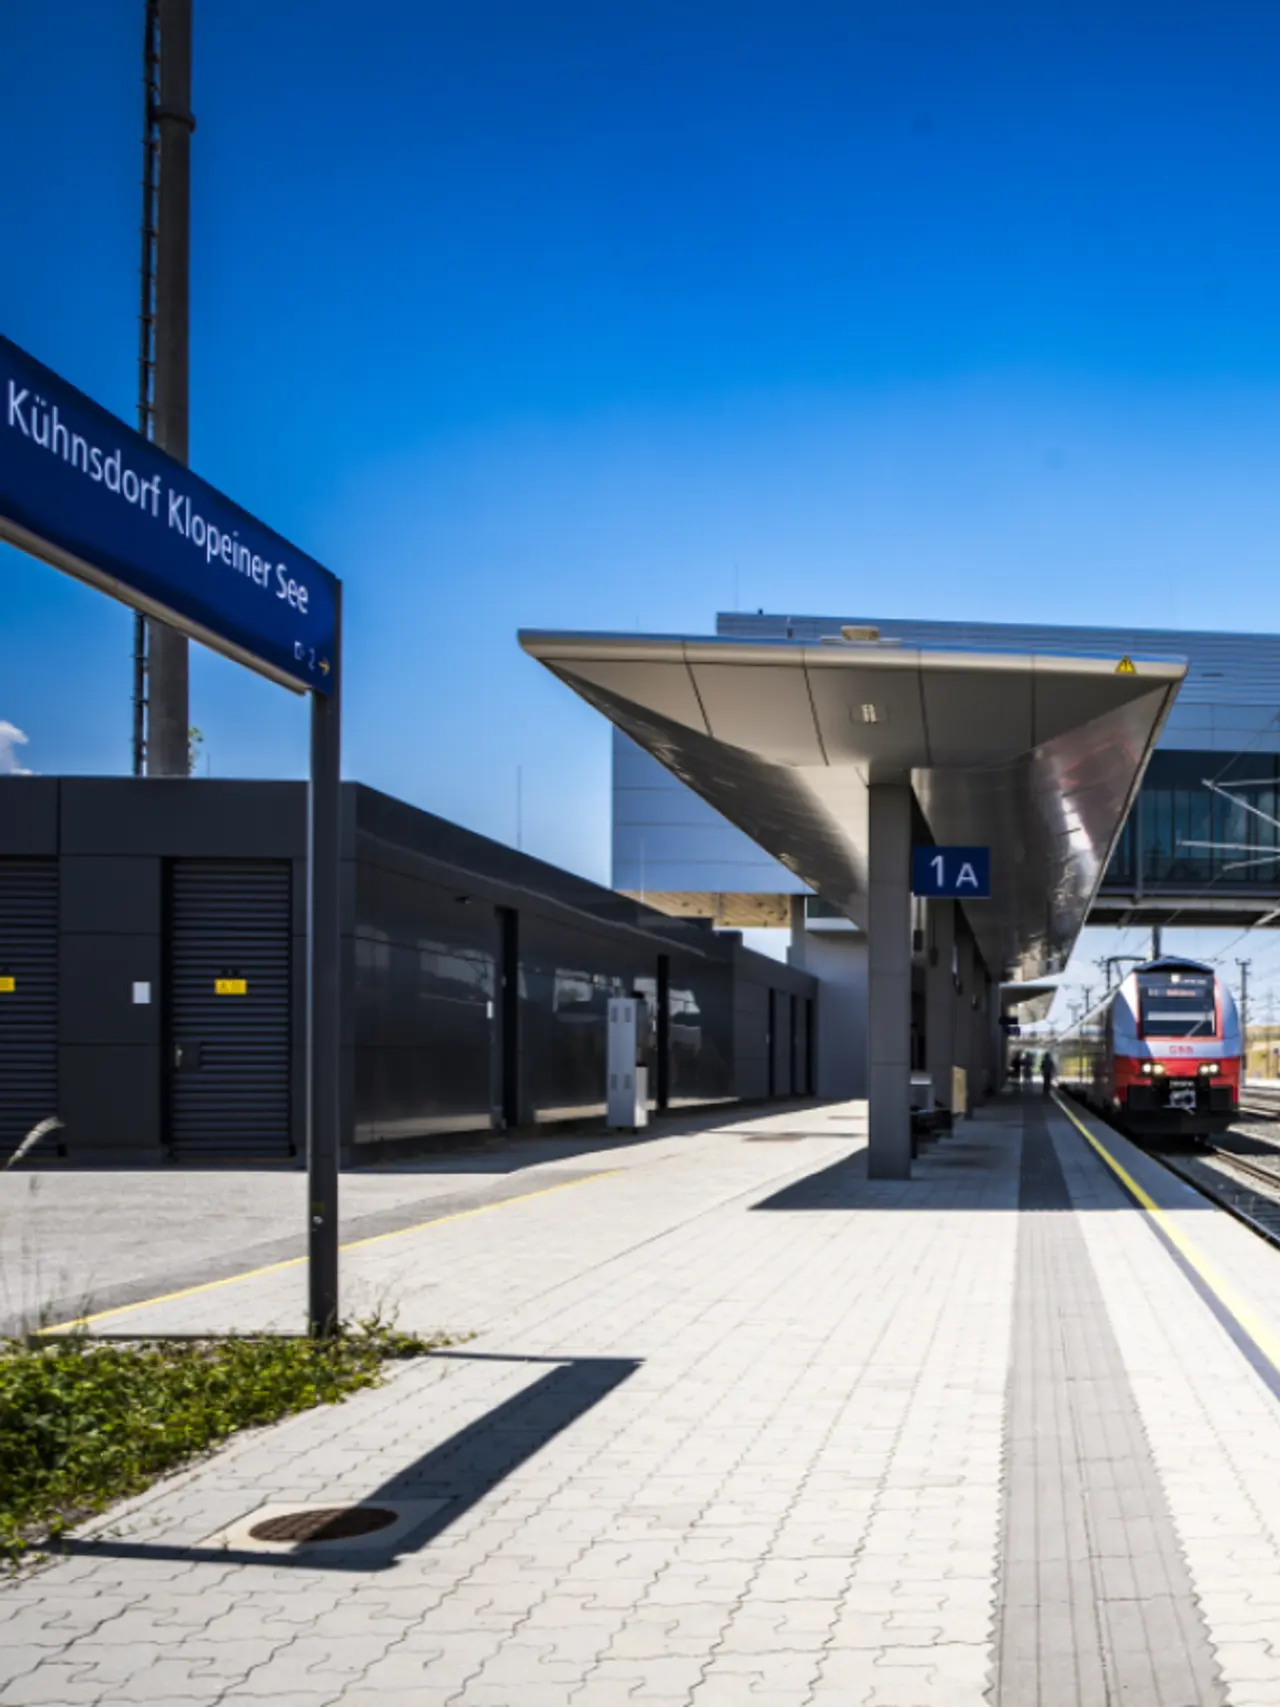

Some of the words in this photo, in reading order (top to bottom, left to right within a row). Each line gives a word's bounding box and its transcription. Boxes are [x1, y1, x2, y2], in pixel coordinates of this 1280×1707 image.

[8, 379, 162, 518] Kühnsdorf
[168, 488, 272, 589] Klopeiner
[275, 563, 309, 615] See
[929, 854, 945, 888] 1
[955, 861, 979, 889] A
